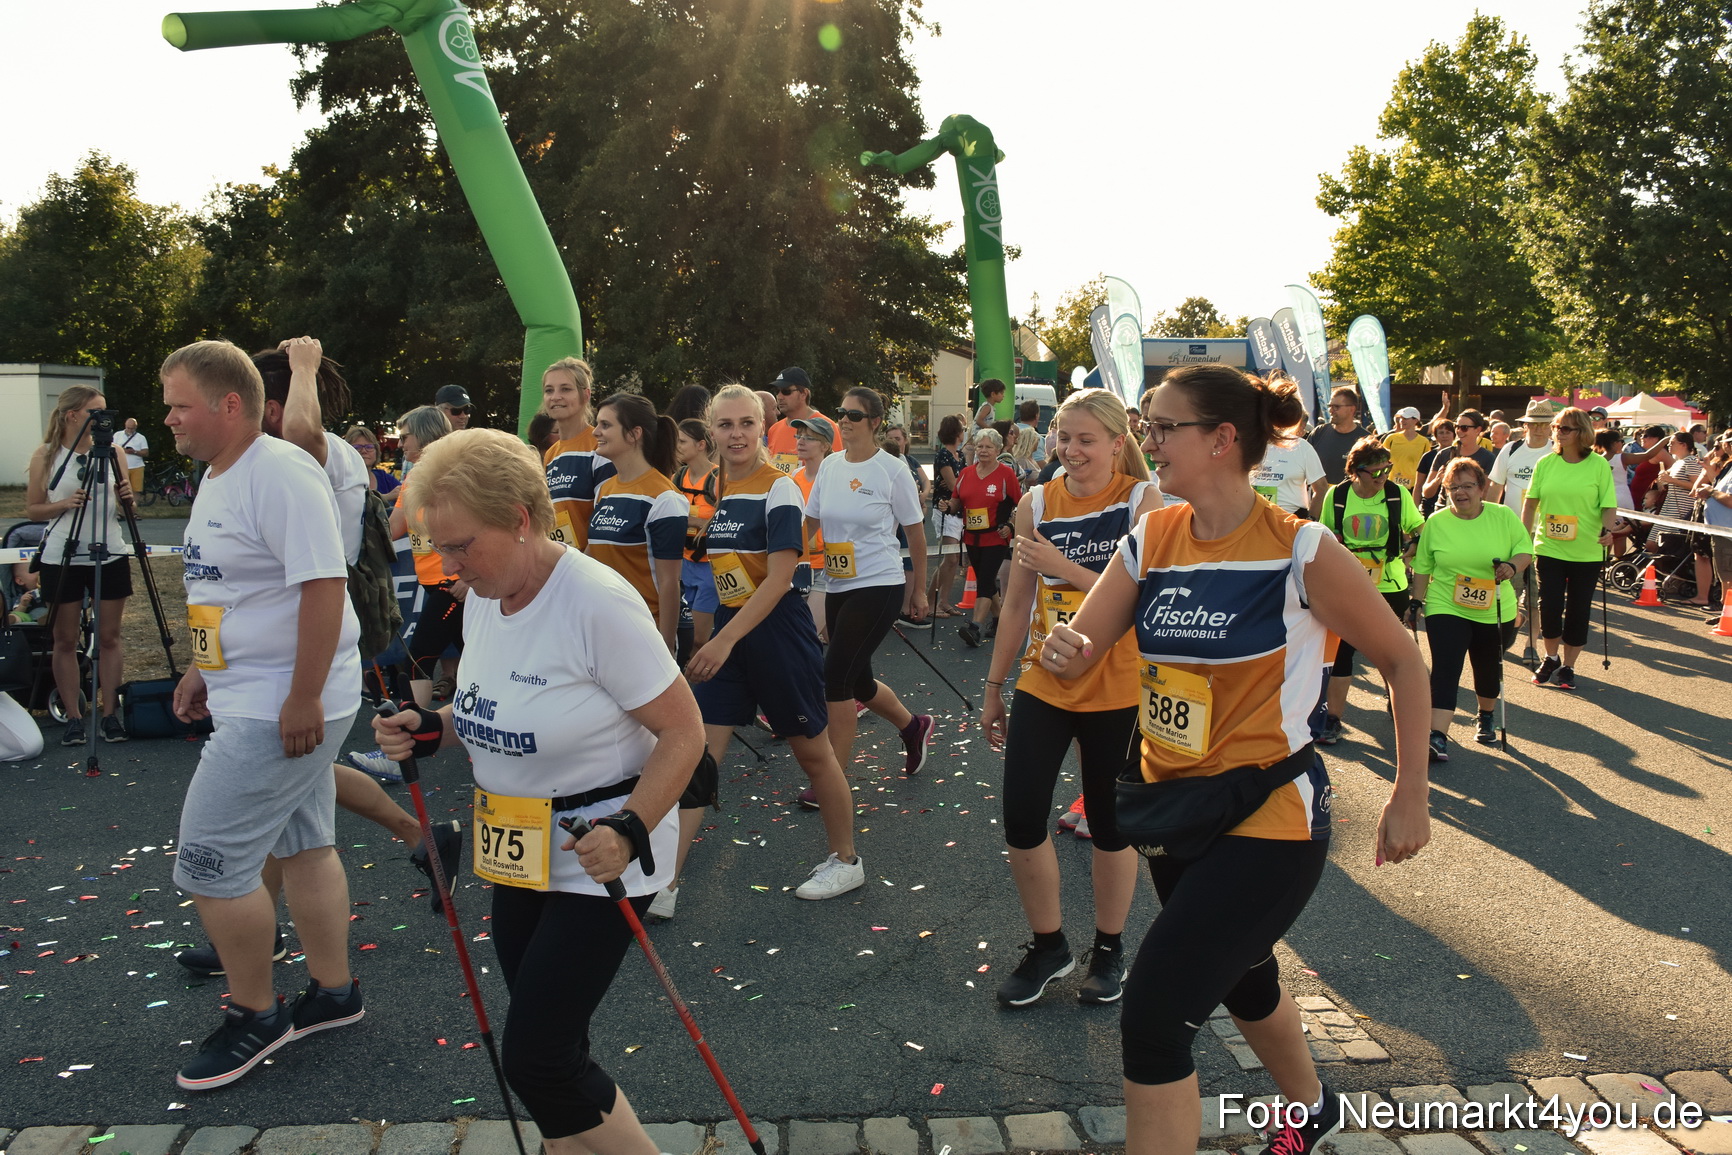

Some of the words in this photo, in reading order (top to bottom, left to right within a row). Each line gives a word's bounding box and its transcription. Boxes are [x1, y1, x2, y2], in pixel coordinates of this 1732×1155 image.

[969, 164, 1002, 244] AOK
[1182, 354, 1222, 363] firmenlauf
[207, 520, 222, 529] Roman
[595, 514, 628, 527] Fischer
[1550, 523, 1568, 534] 350
[715, 572, 738, 592] 600
[1462, 586, 1487, 601] 348
[1151, 605, 1238, 627] Fischer
[1153, 628, 1227, 639] AUTOMOBILE
[509, 671, 547, 686] Roswitha
[1148, 691, 1190, 730] 588
[1148, 719, 1165, 732] Renner
[1166, 727, 1188, 741] Marion
[481, 823, 524, 861] 975
[179, 846, 224, 875] LONSDALE
[493, 859, 524, 872] Roswitha
[488, 867, 512, 879] Engineering
